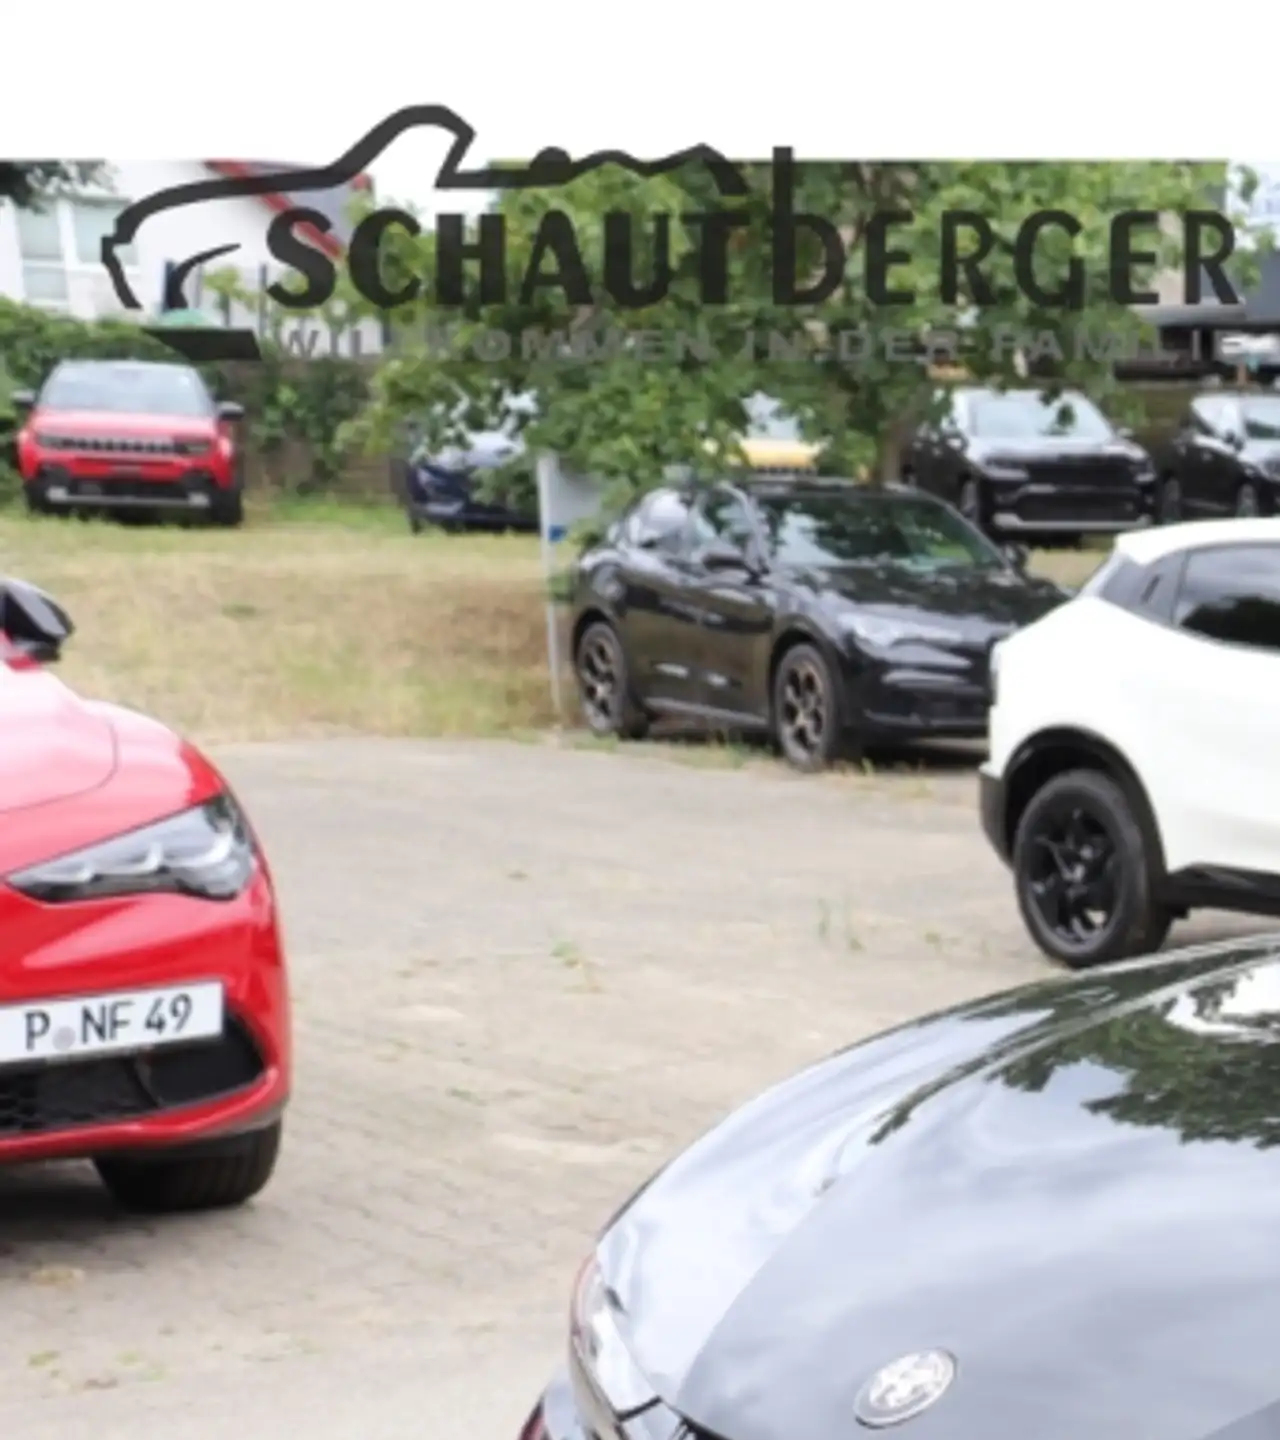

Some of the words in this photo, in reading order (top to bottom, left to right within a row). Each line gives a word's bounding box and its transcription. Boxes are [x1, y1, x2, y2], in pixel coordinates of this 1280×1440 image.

[25, 1010, 50, 1051] P
[81, 1001, 134, 1044] NF
[144, 993, 192, 1034] 49
